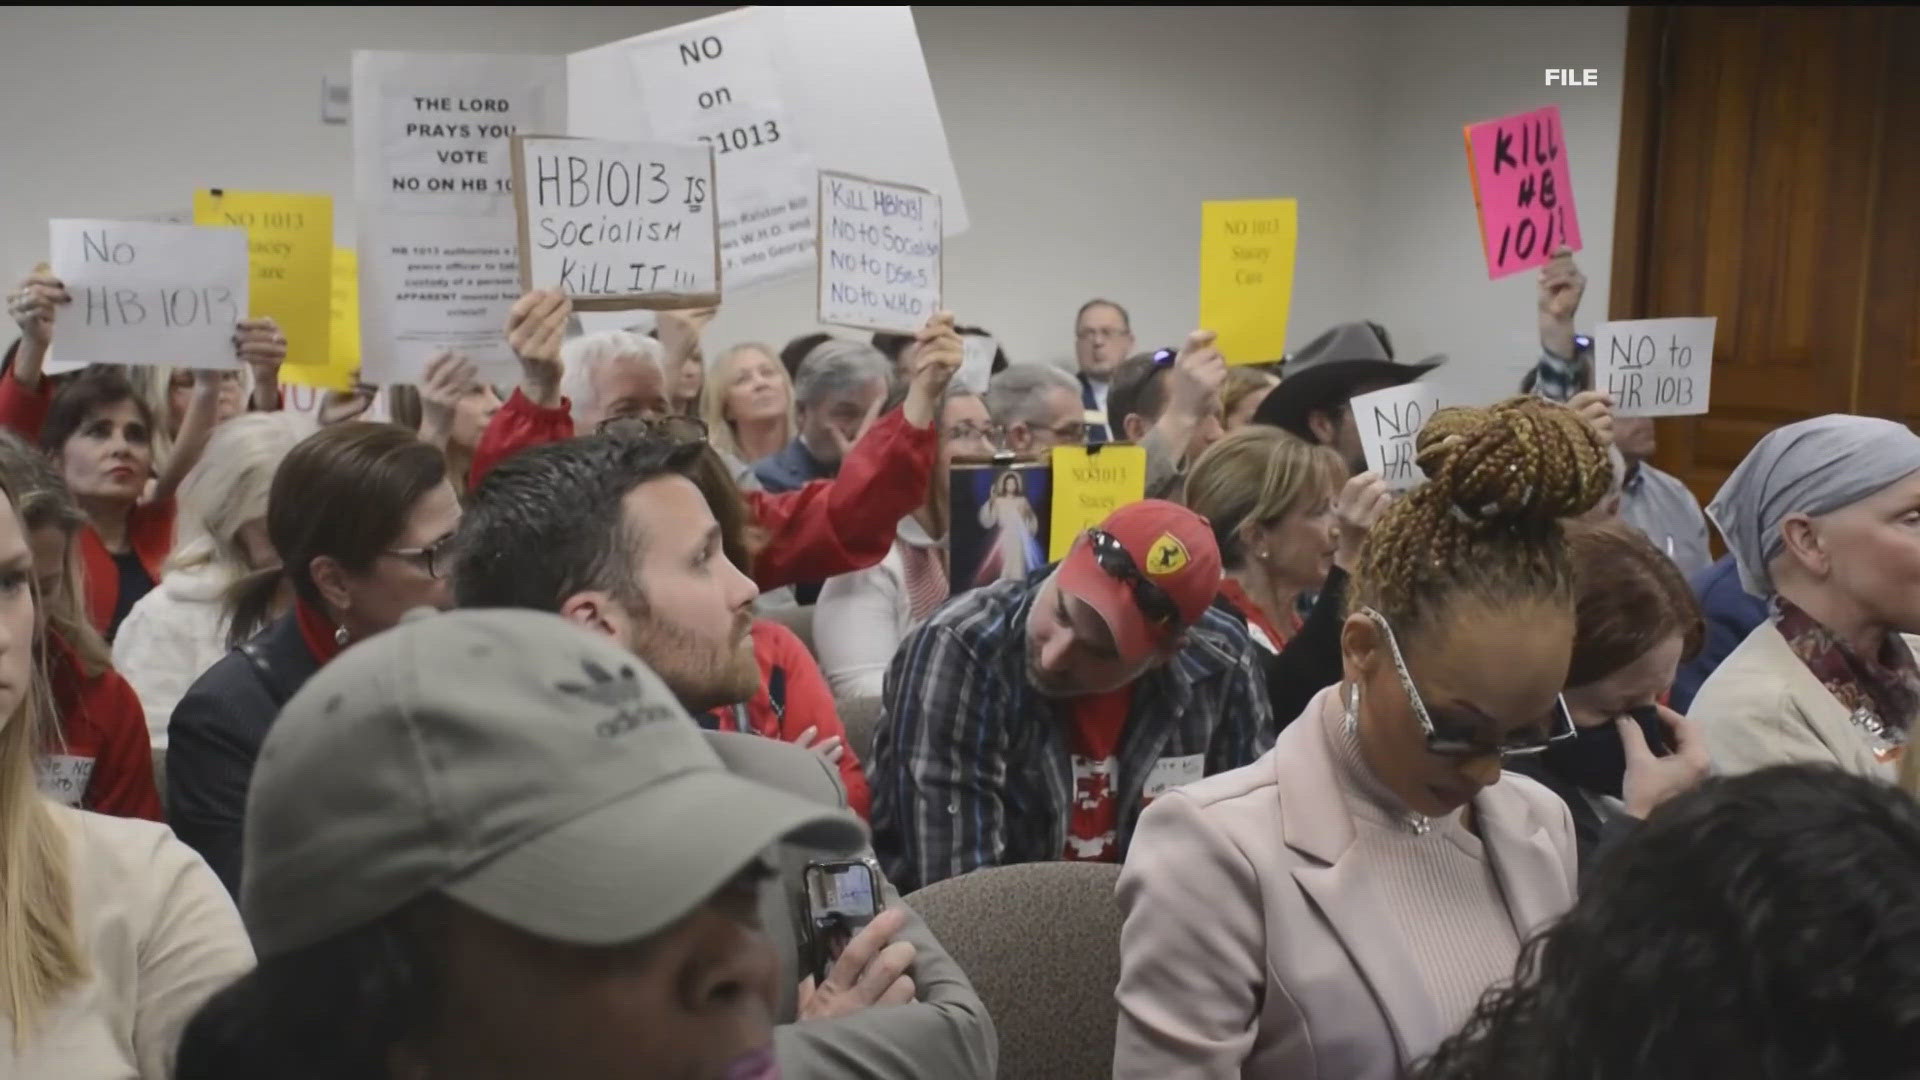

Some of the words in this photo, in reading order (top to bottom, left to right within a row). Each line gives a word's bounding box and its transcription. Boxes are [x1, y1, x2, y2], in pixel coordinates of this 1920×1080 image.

[679, 36, 723, 66] NO
[414, 97, 451, 111] THE
[459, 98, 509, 112] LORD
[698, 87, 732, 109] on
[407, 123, 470, 138] PRAYS
[478, 124, 517, 138] YOU
[1494, 116, 1558, 174] KILL
[437, 150, 488, 164] VOTE
[392, 177, 420, 191] NO
[428, 178, 454, 191] ON
[461, 178, 487, 191] HB
[537, 155, 670, 207] HB1013
[683, 176, 706, 204] IS
[224, 212, 254, 226] NO
[248, 242, 293, 257] acey
[86, 287, 146, 326] HB
[161, 287, 238, 327] 1013
[1610, 334, 1656, 369] NO
[1669, 334, 1692, 367] to
[1655, 376, 1694, 405] 1013
[1374, 400, 1421, 437] NO
[1381, 441, 1412, 479] HR
